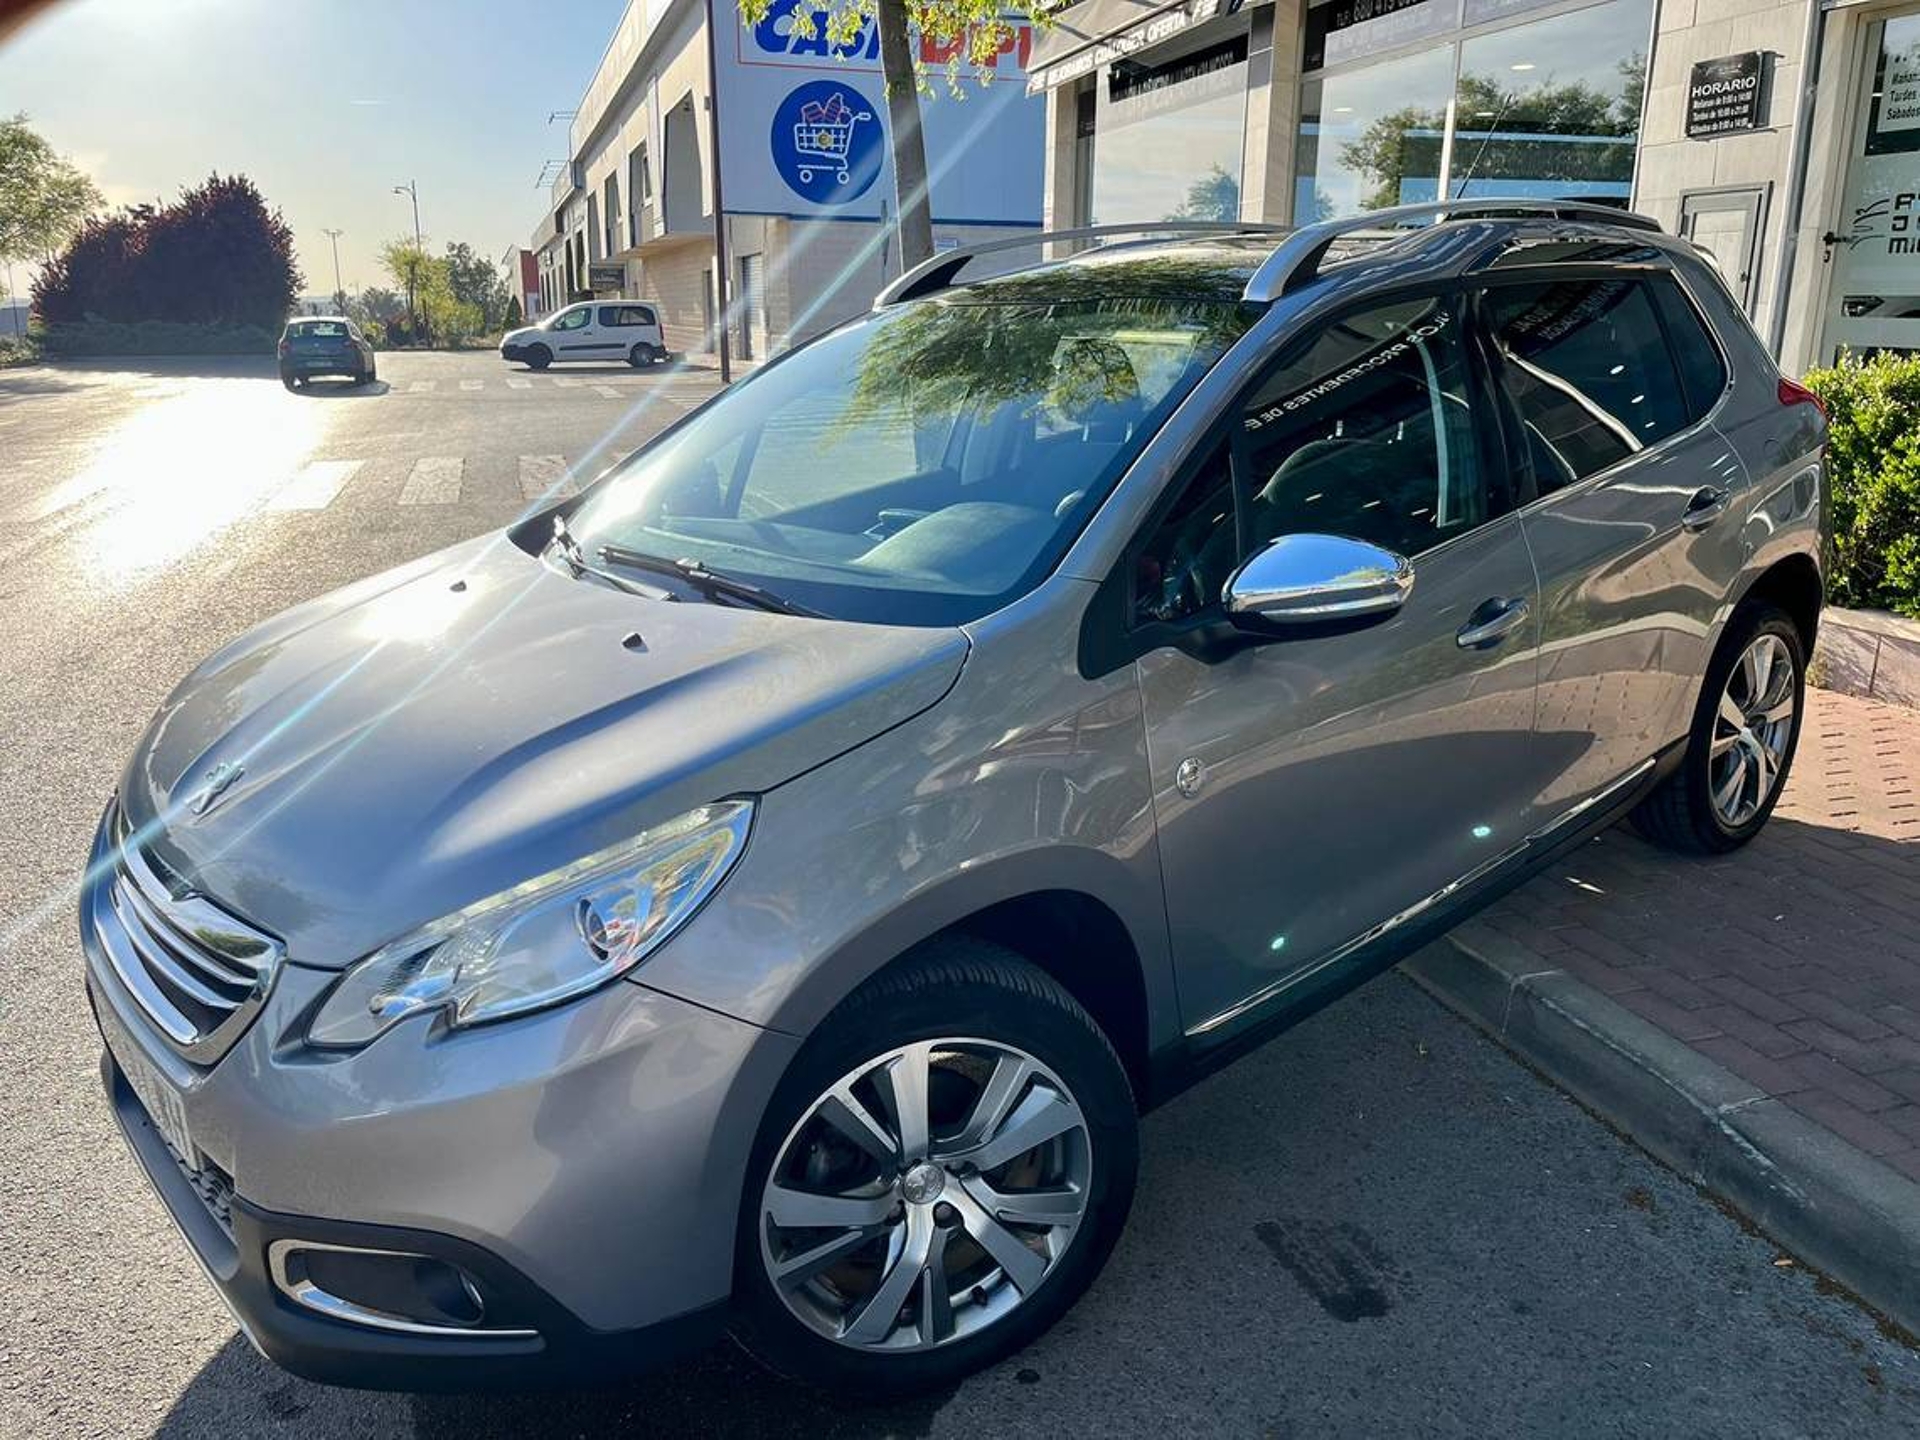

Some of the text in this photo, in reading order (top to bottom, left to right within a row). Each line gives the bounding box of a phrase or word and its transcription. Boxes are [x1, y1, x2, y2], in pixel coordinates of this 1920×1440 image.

[755, 0, 881, 60] CAS
[1147, 10, 1186, 42] OFERTA
[1692, 76, 1756, 98] HORARIO
